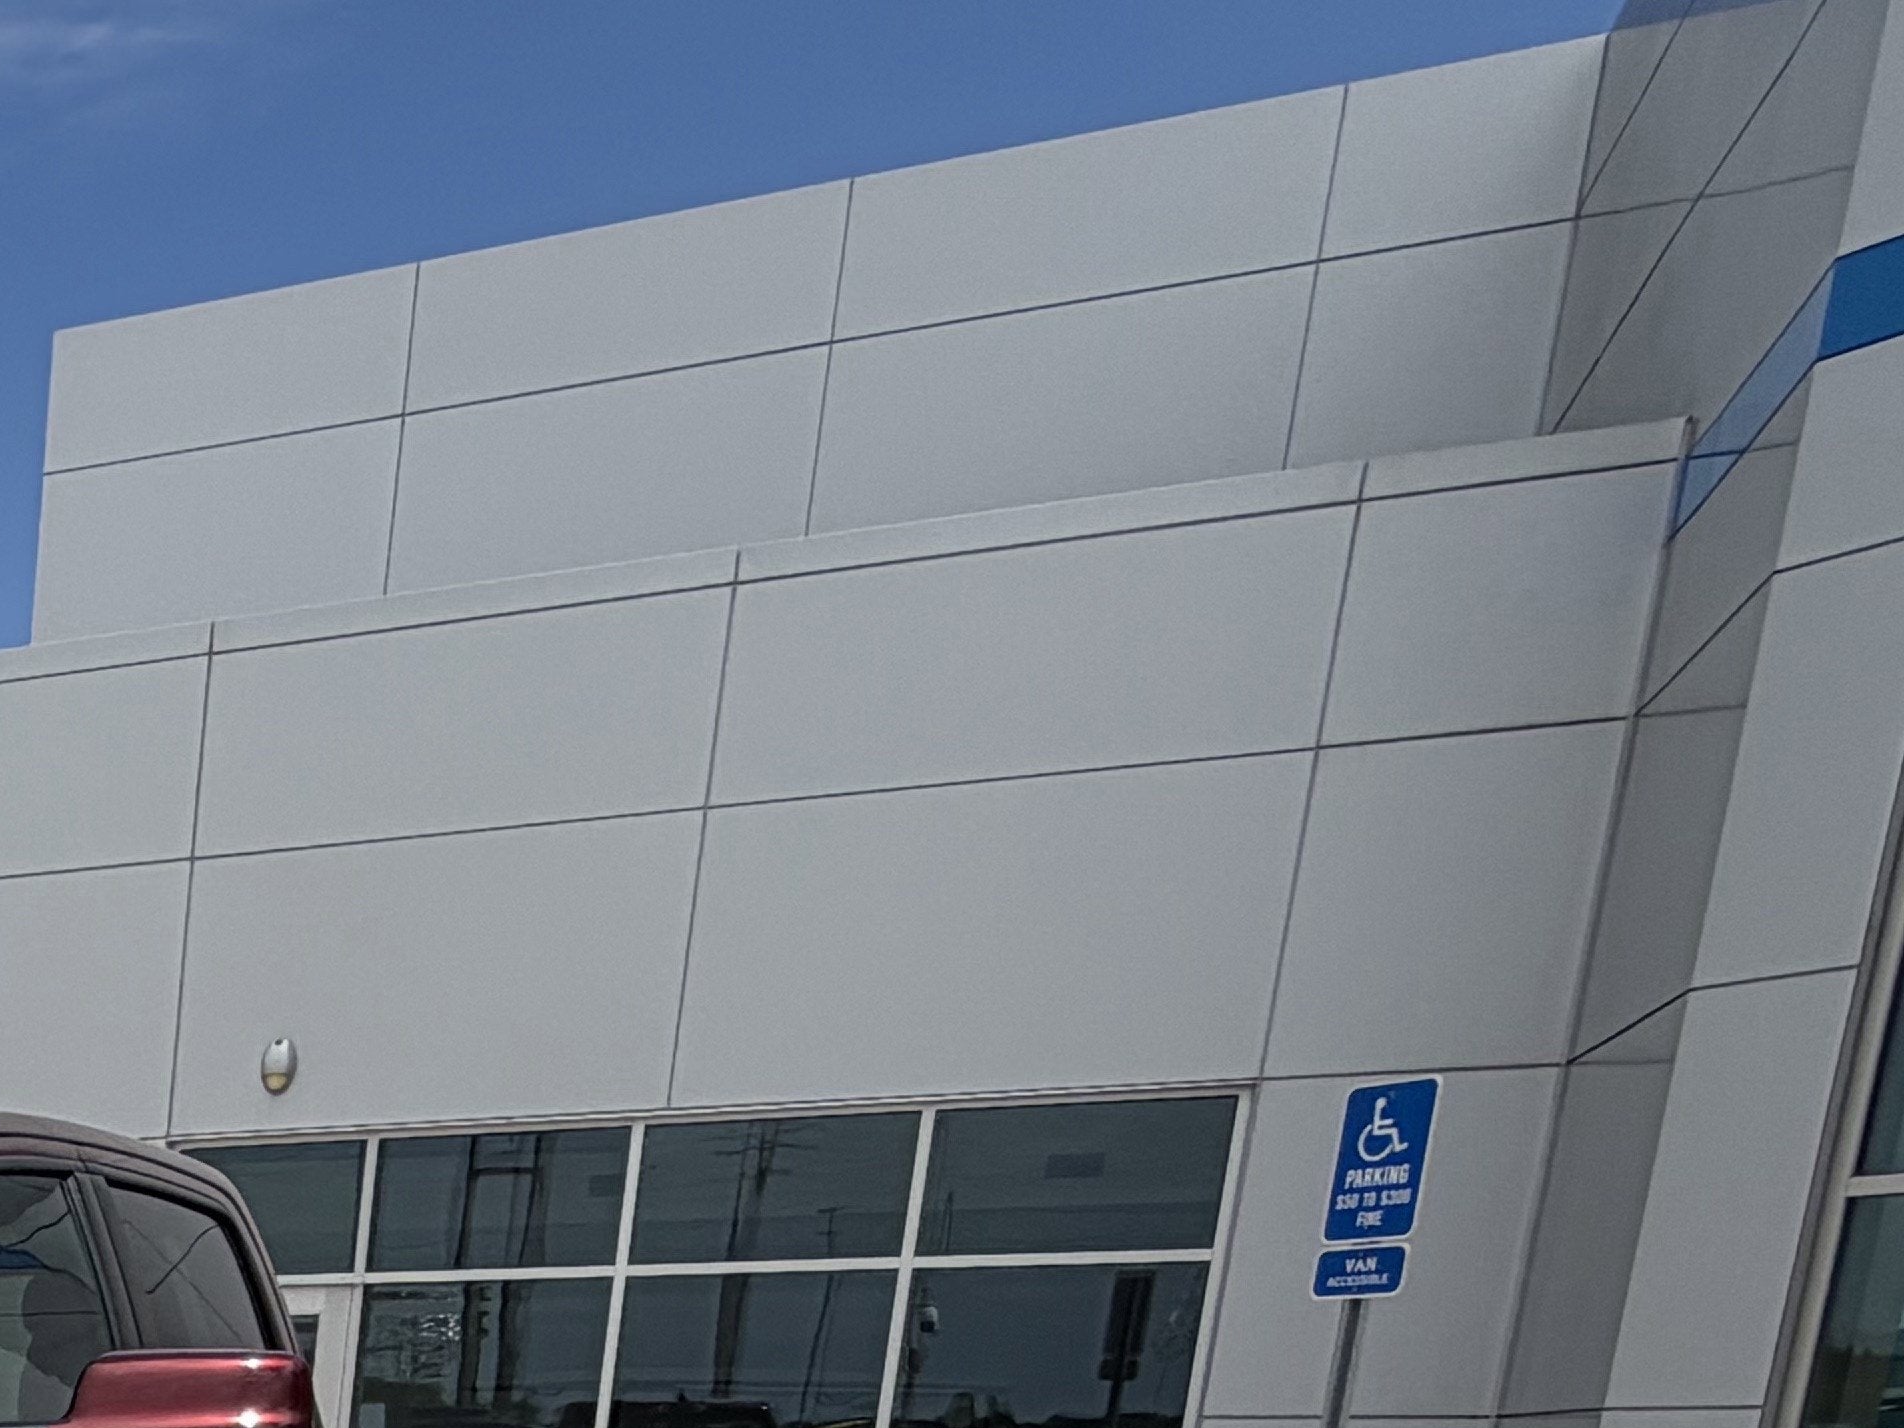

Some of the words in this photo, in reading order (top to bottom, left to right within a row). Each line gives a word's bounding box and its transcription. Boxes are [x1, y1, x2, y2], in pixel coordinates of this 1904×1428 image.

[1344, 1163, 1410, 1190] PARKING
[1362, 1190, 1377, 1207] TO
[1355, 1210, 1384, 1229] FINE
[1345, 1256, 1378, 1274] VAN
